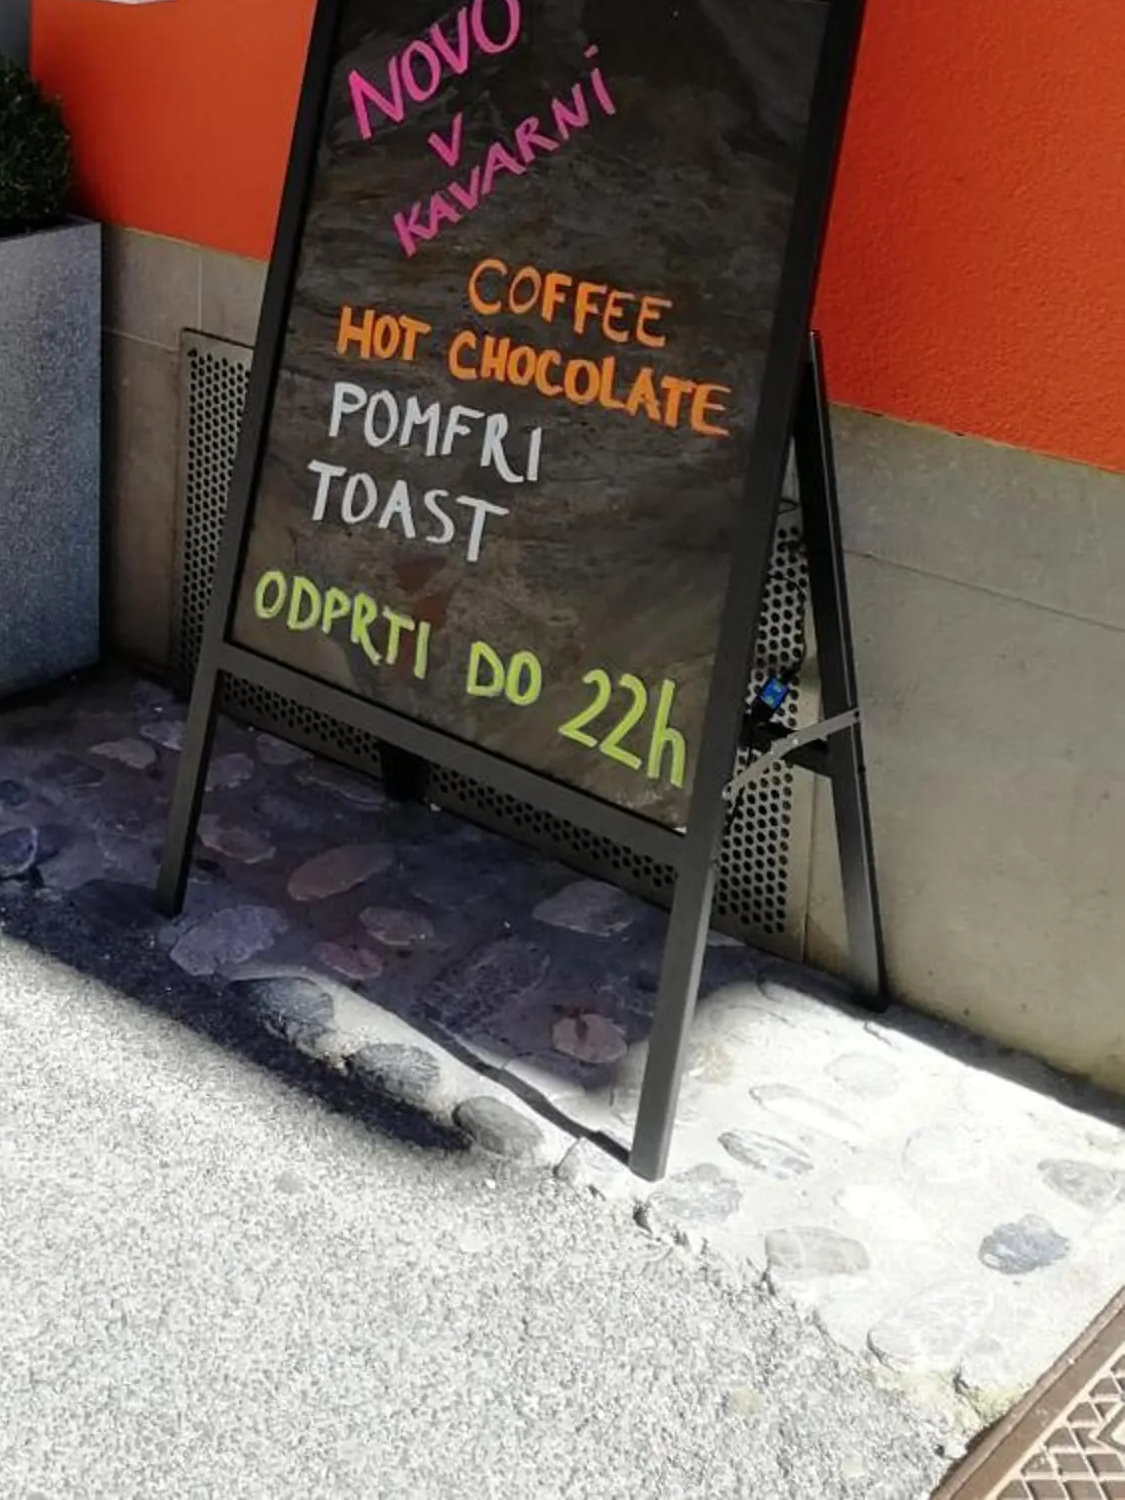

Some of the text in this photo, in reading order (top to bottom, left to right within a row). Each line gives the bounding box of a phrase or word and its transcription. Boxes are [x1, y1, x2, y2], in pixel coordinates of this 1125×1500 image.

[430, 111, 464, 168] V
[468, 258, 673, 349] COFFEE
[335, 306, 734, 438] HOT CHOCOLATE
[327, 381, 543, 483] POMFRI
[306, 460, 511, 563] TOAST
[253, 568, 688, 789] ODPRTI DO 22h
